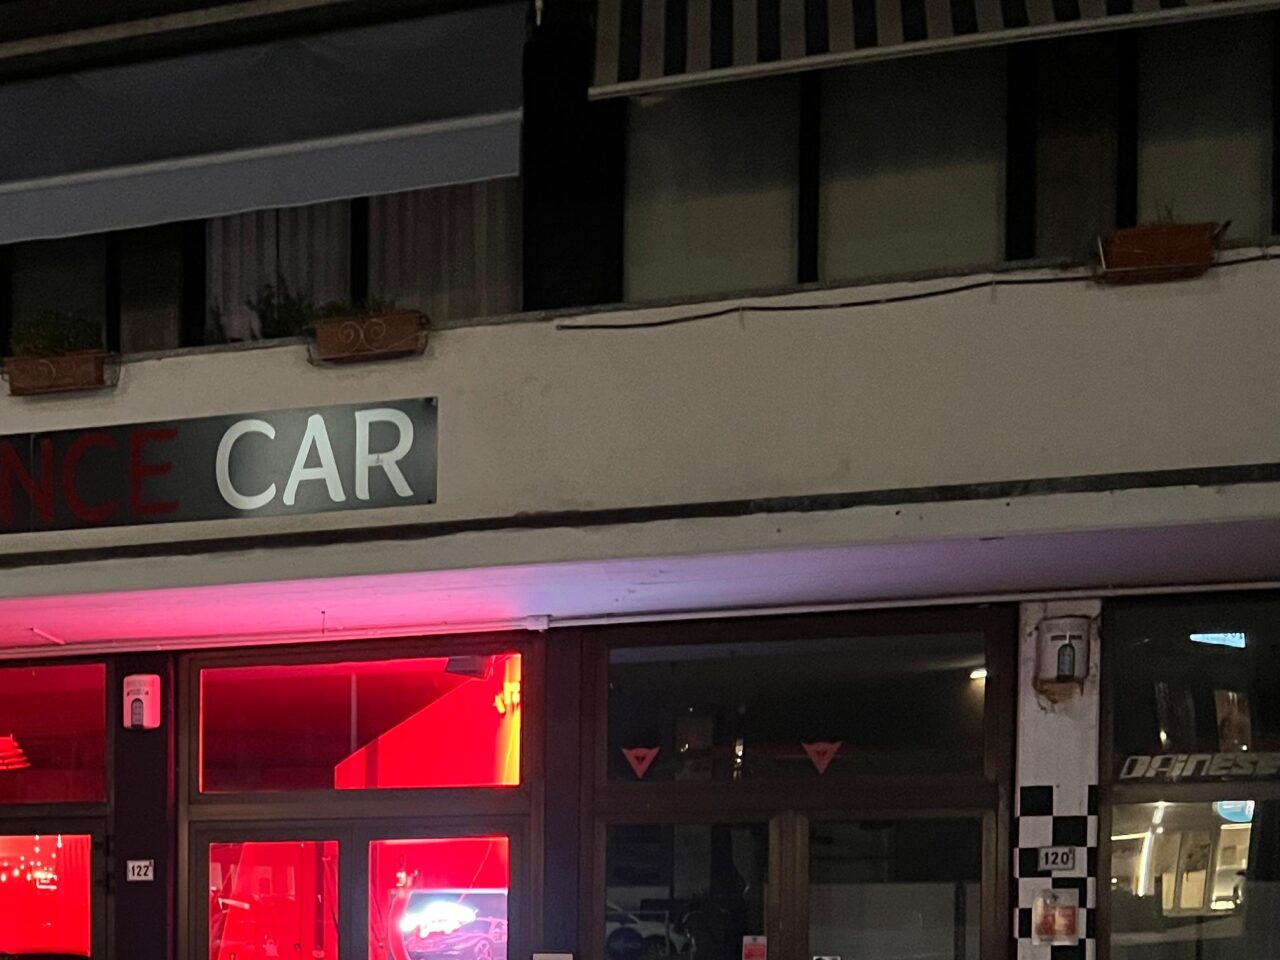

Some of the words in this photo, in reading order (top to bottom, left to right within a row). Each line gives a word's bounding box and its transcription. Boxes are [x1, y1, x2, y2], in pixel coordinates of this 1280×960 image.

[215, 407, 415, 511] CAR
[1044, 852, 1070, 866] 120
[131, 864, 150, 877] 122
